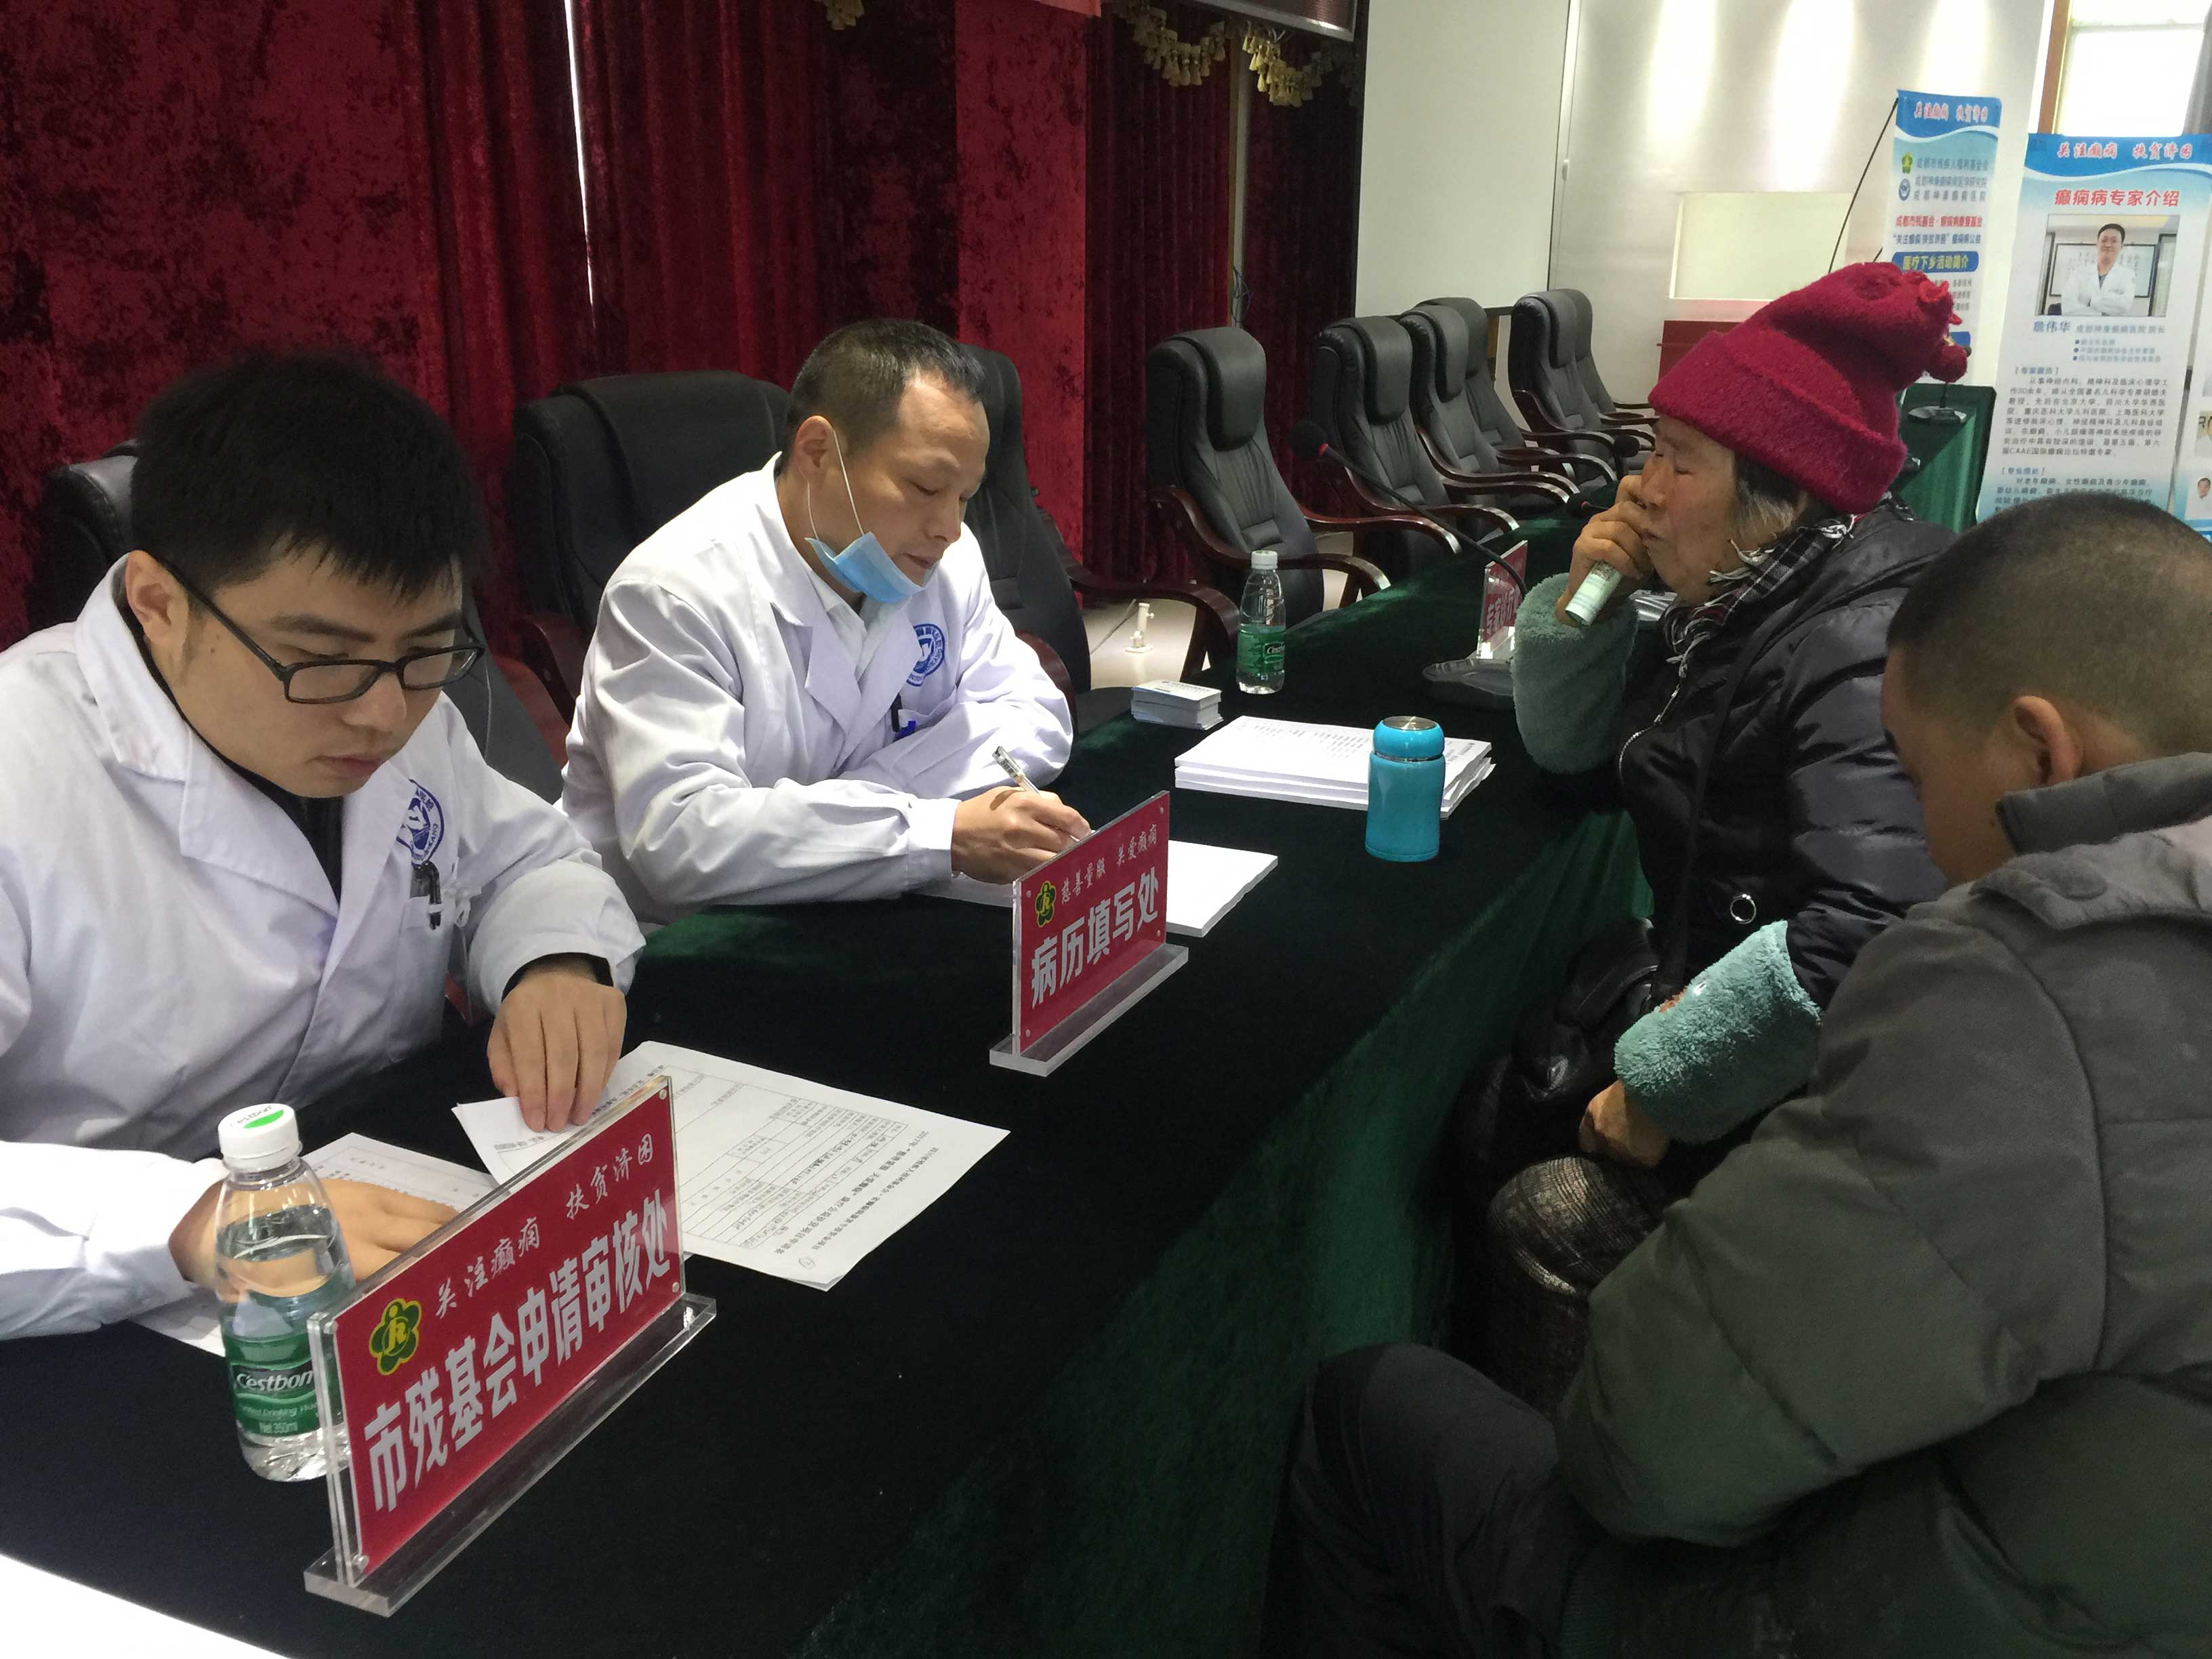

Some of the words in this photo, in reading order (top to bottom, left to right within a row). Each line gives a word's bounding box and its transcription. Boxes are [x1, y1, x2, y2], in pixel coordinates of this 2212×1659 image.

[2055, 189, 2179, 207] 癫痫病专家介绍
[1031, 867, 1160, 1010] 病历填写处
[434, 1216, 541, 1320] 关注癫痫
[565, 1132, 656, 1222] 扶贫济困
[364, 1189, 672, 1513] 市残基会申请审核处
